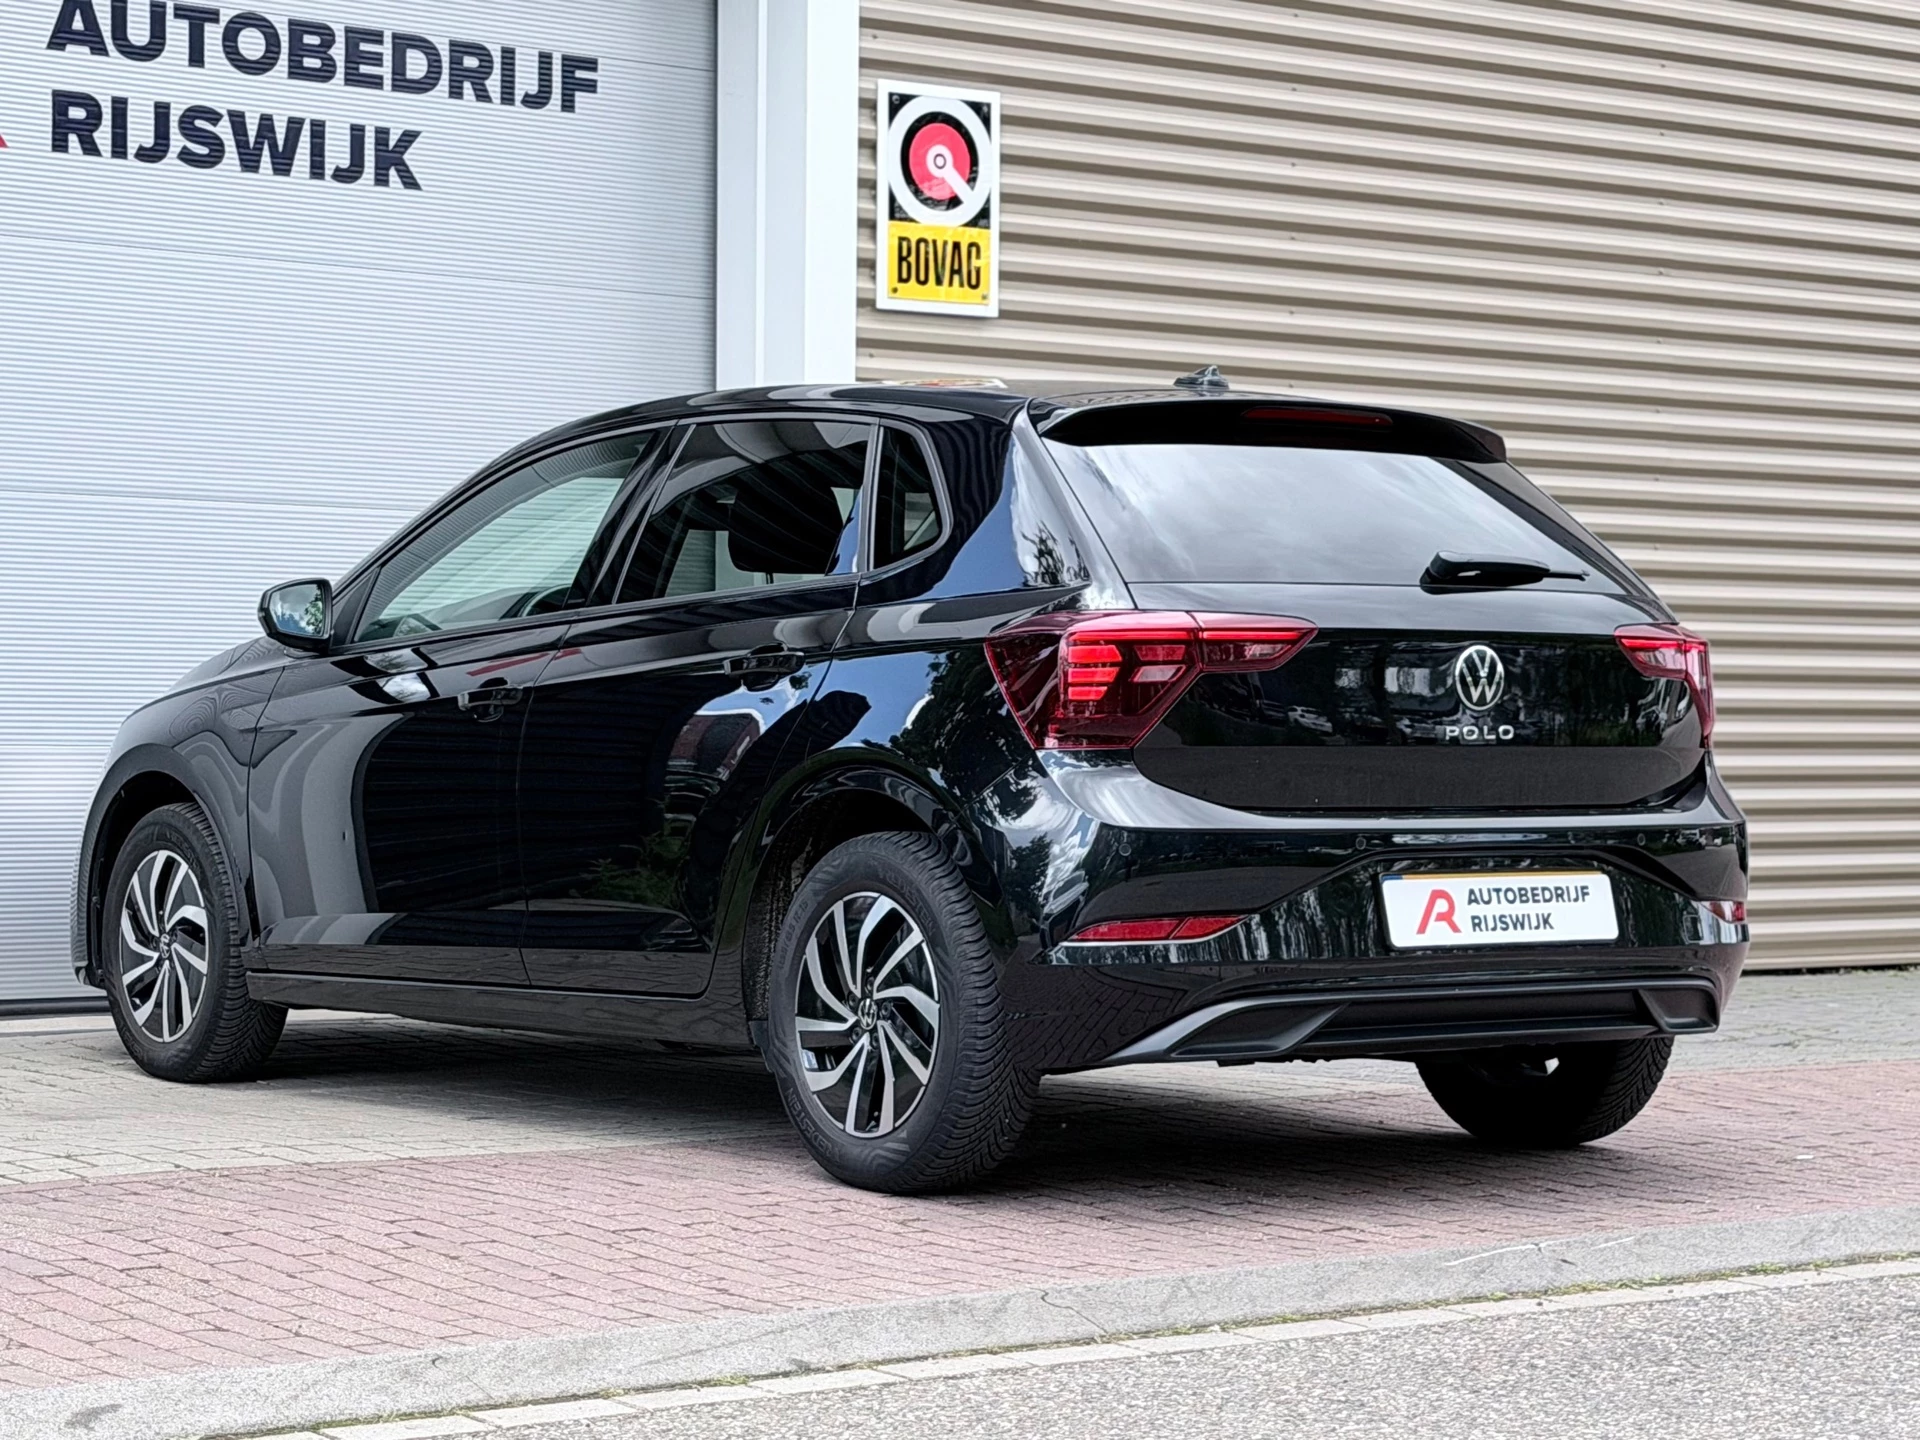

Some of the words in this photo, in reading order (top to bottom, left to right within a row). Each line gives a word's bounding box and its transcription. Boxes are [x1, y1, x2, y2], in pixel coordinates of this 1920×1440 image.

[46, 0, 599, 113] AUTOBEDRIJF
[51, 89, 423, 191] RIJSWIJK
[897, 235, 981, 290] BOVAG
[1445, 724, 1515, 741] POLO
[1467, 885, 1590, 906] AUTOBEDRIJF
[1471, 912, 1555, 933] RIJSWIJK
